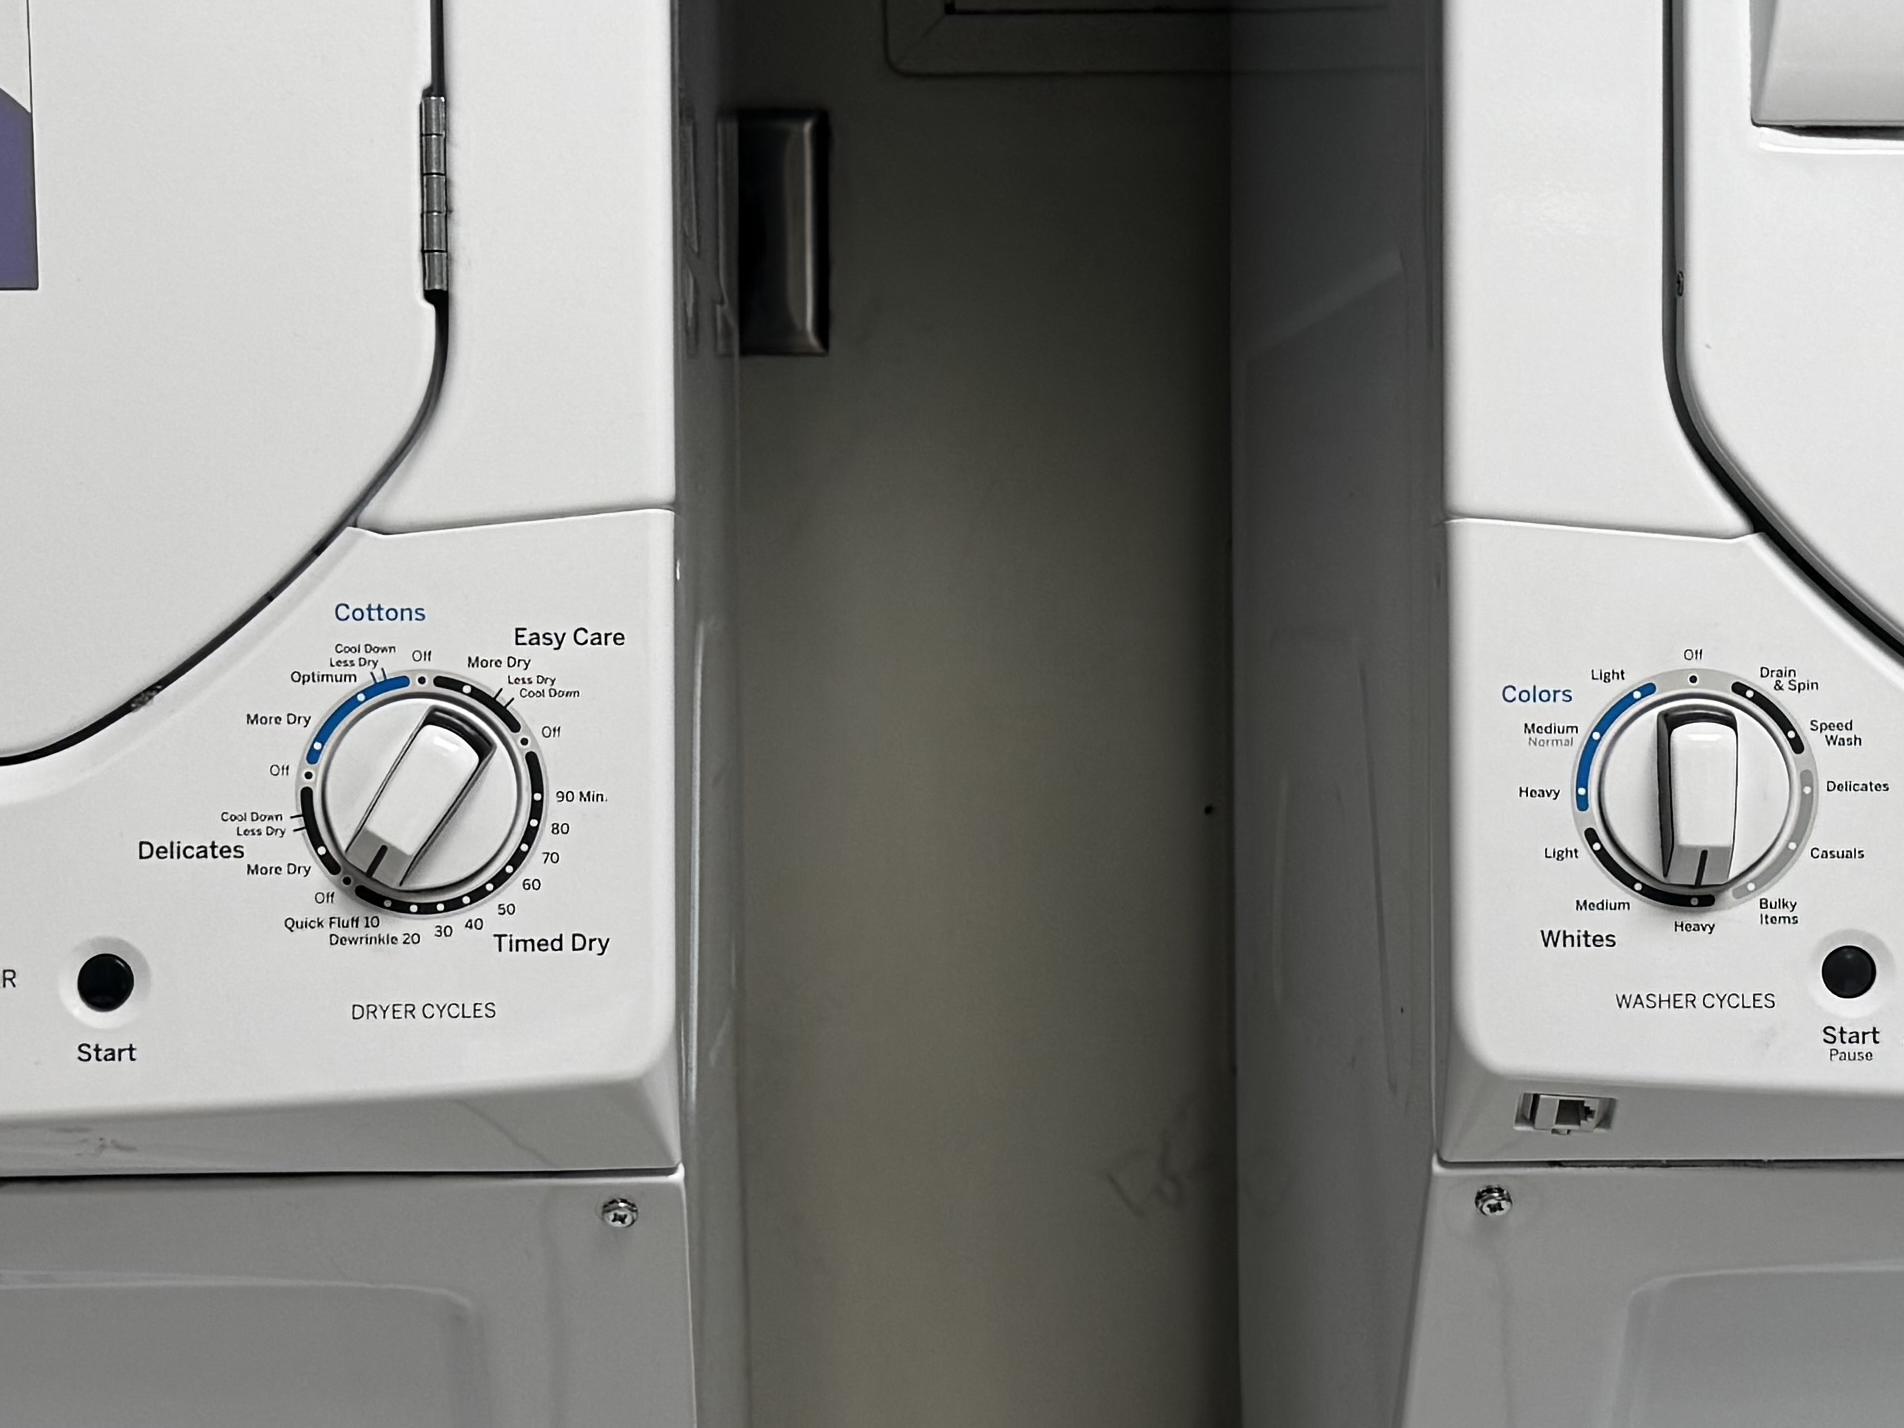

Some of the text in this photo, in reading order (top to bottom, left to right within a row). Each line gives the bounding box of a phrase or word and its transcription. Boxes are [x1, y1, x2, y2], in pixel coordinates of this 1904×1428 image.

[335, 603, 425, 621] Cottons
[515, 627, 625, 650] Easy Care
[291, 671, 357, 685] Optimum
[1592, 669, 1625, 683] Light
[1502, 685, 1572, 703] Colors
[556, 791, 608, 802] 90 Min.
[551, 823, 569, 835] 80
[522, 879, 541, 890] 60
[284, 916, 380, 932] Quick Fluff 10
[493, 933, 610, 956] Timed Dry
[1541, 930, 1616, 947] Whites
[1616, 993, 1775, 1009] WASHER CYCLES
[352, 1002, 496, 1020] DRYER CYCLES
[1823, 1026, 1880, 1044] Start
[78, 1043, 136, 1062] Start
[1830, 1048, 1873, 1061] Pause
